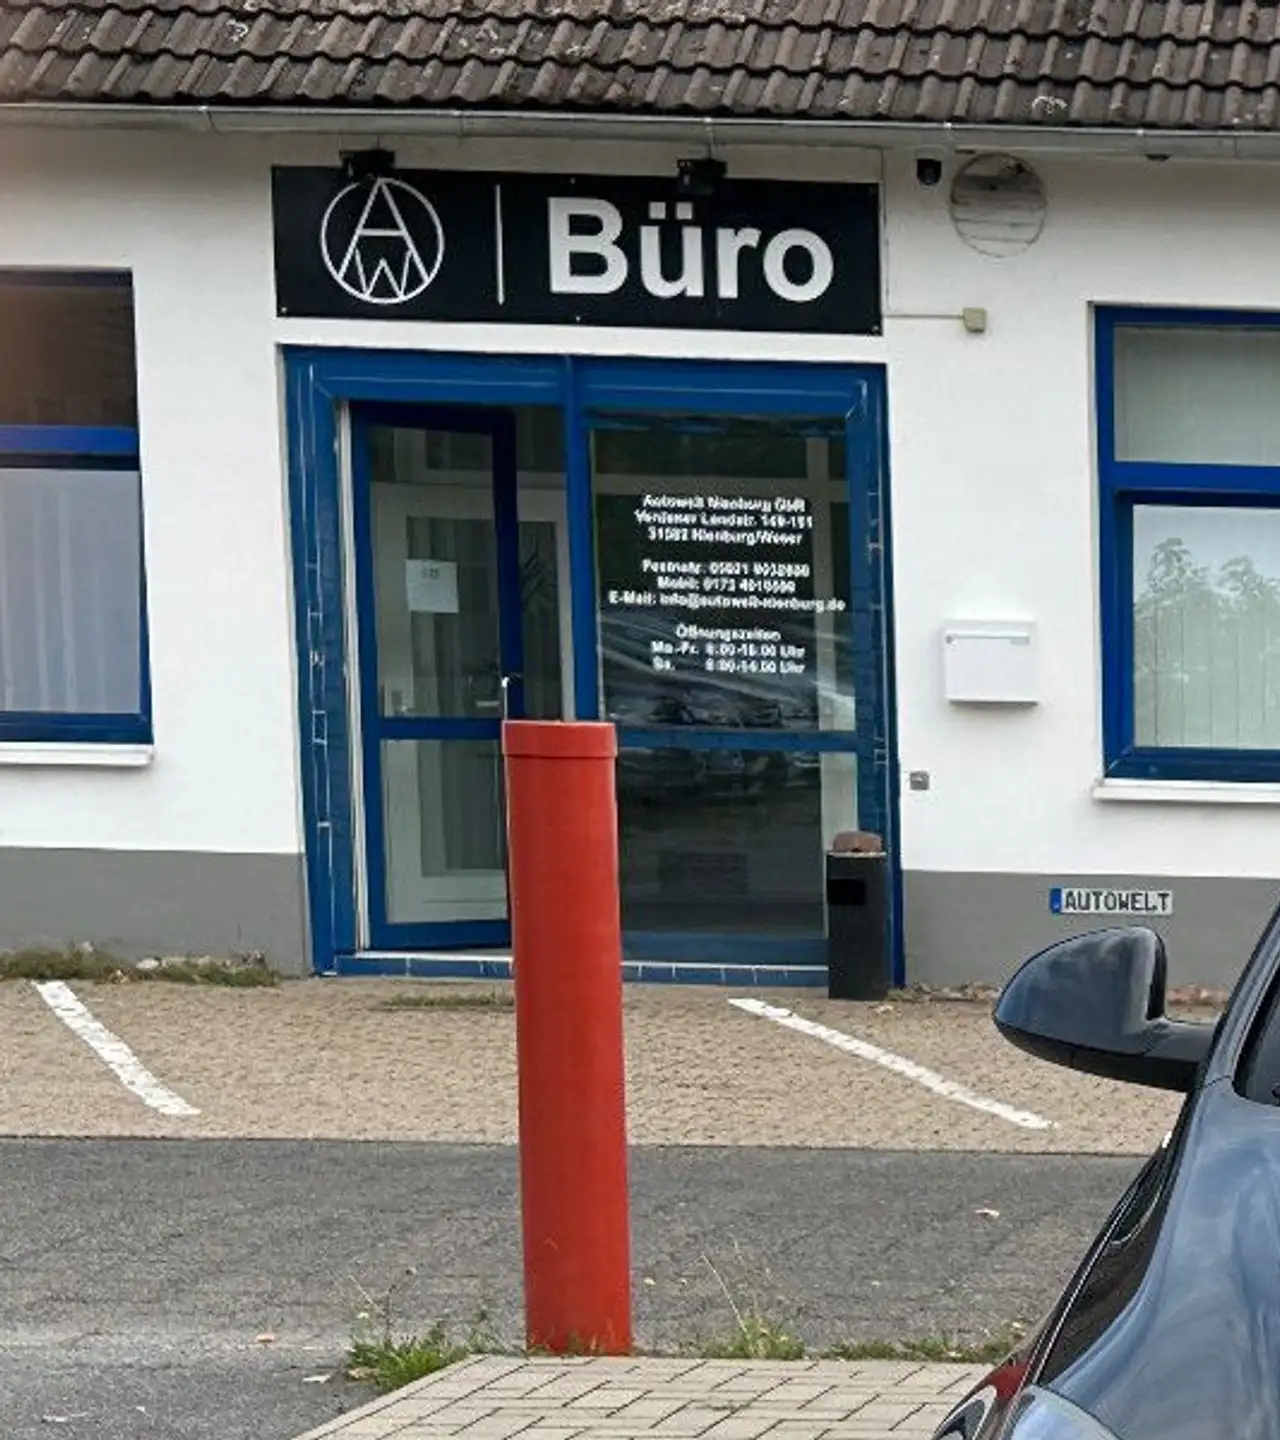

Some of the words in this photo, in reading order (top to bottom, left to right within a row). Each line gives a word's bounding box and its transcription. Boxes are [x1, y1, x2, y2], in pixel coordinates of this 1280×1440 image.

[548, 196, 834, 303] Büro
[643, 495, 704, 510] Autowelt
[707, 496, 771, 513] Nienburg
[608, 590, 656, 604] E-Mail:
[780, 644, 805, 658] Uhr
[780, 659, 805, 674] Uhr
[1065, 890, 1170, 911] AUTOWELT
